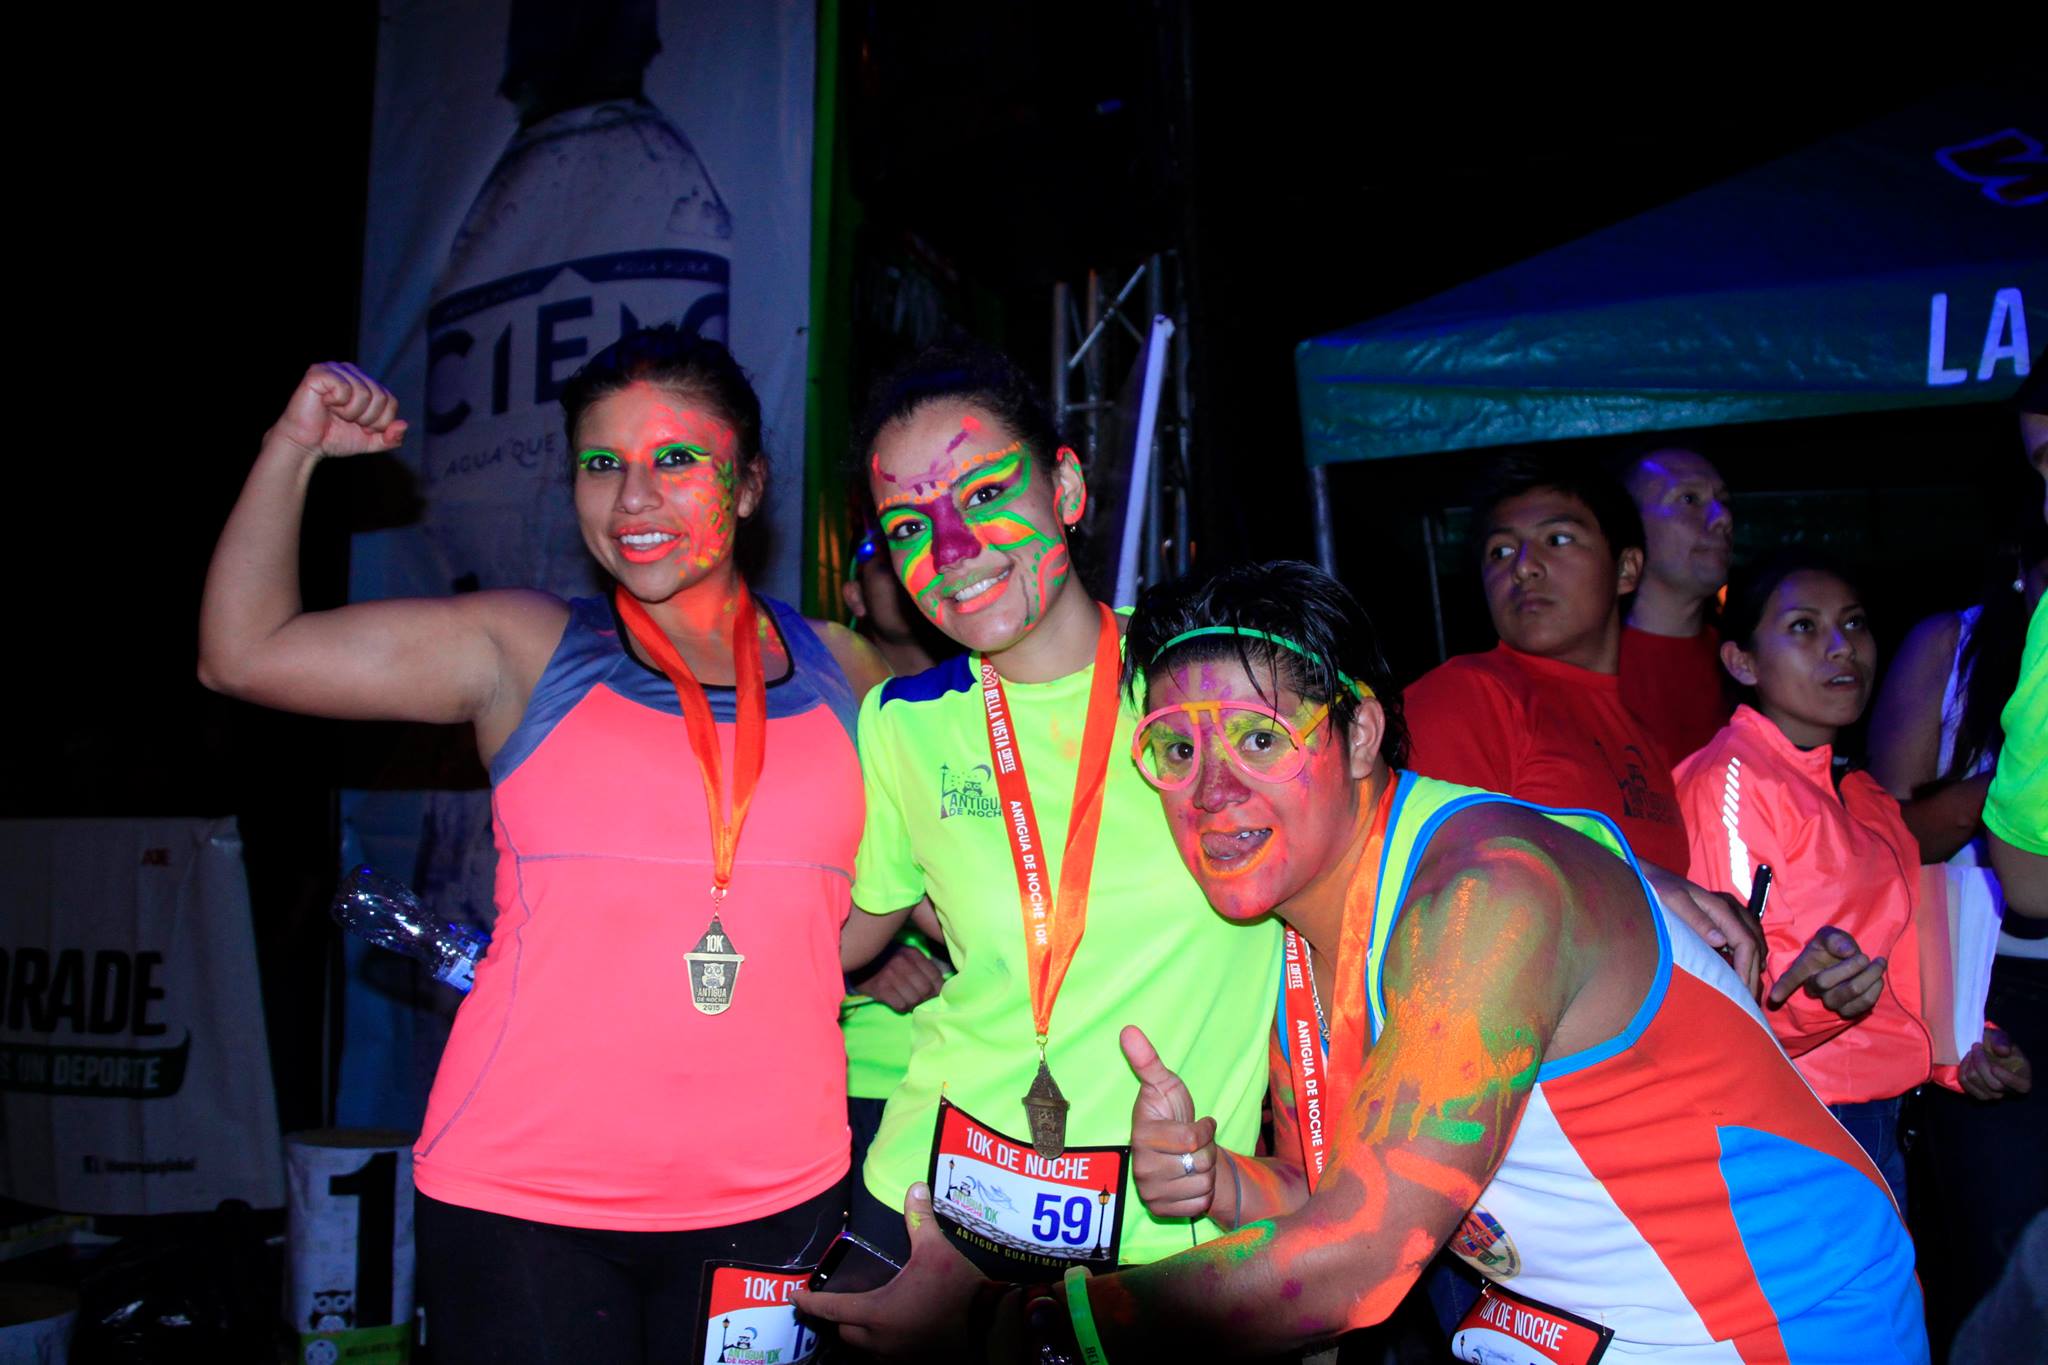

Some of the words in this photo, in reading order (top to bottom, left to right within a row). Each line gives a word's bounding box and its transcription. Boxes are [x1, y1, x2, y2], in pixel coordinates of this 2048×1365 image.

[1926, 287, 2031, 386] LA
[984, 688, 1003, 720] BELLA
[991, 718, 1010, 749] VISTA
[949, 807, 963, 817] DE
[967, 808, 1003, 818] NOCH
[950, 792, 1002, 811] ANTIGU
[1010, 801, 1032, 852] ANTIGUA
[1023, 853, 1036, 871] DE
[1026, 872, 1046, 920] NOCHE
[705, 934, 725, 953] 10K
[1034, 921, 1049, 945] 10K
[1286, 930, 1300, 960] VISTA
[1297, 1019, 1315, 1077] ANTIGUA
[52, 1056, 163, 1091] DEPORTE
[1306, 1079, 1319, 1097] DE
[1307, 1098, 1324, 1147] NOCHE
[966, 1126, 994, 1160] 10K
[996, 1142, 1020, 1172] DE
[1025, 1153, 1091, 1180] NOCHE
[1031, 1192, 1093, 1246] 59
[329, 1152, 397, 1327] 1
[955, 1226, 999, 1254] ANTIGUA
[1004, 1249, 1074, 1269] GUATEMALA
[743, 1276, 778, 1302] 10K
[1495, 1302, 1513, 1331] DE
[1514, 1309, 1568, 1352] NOCHE
